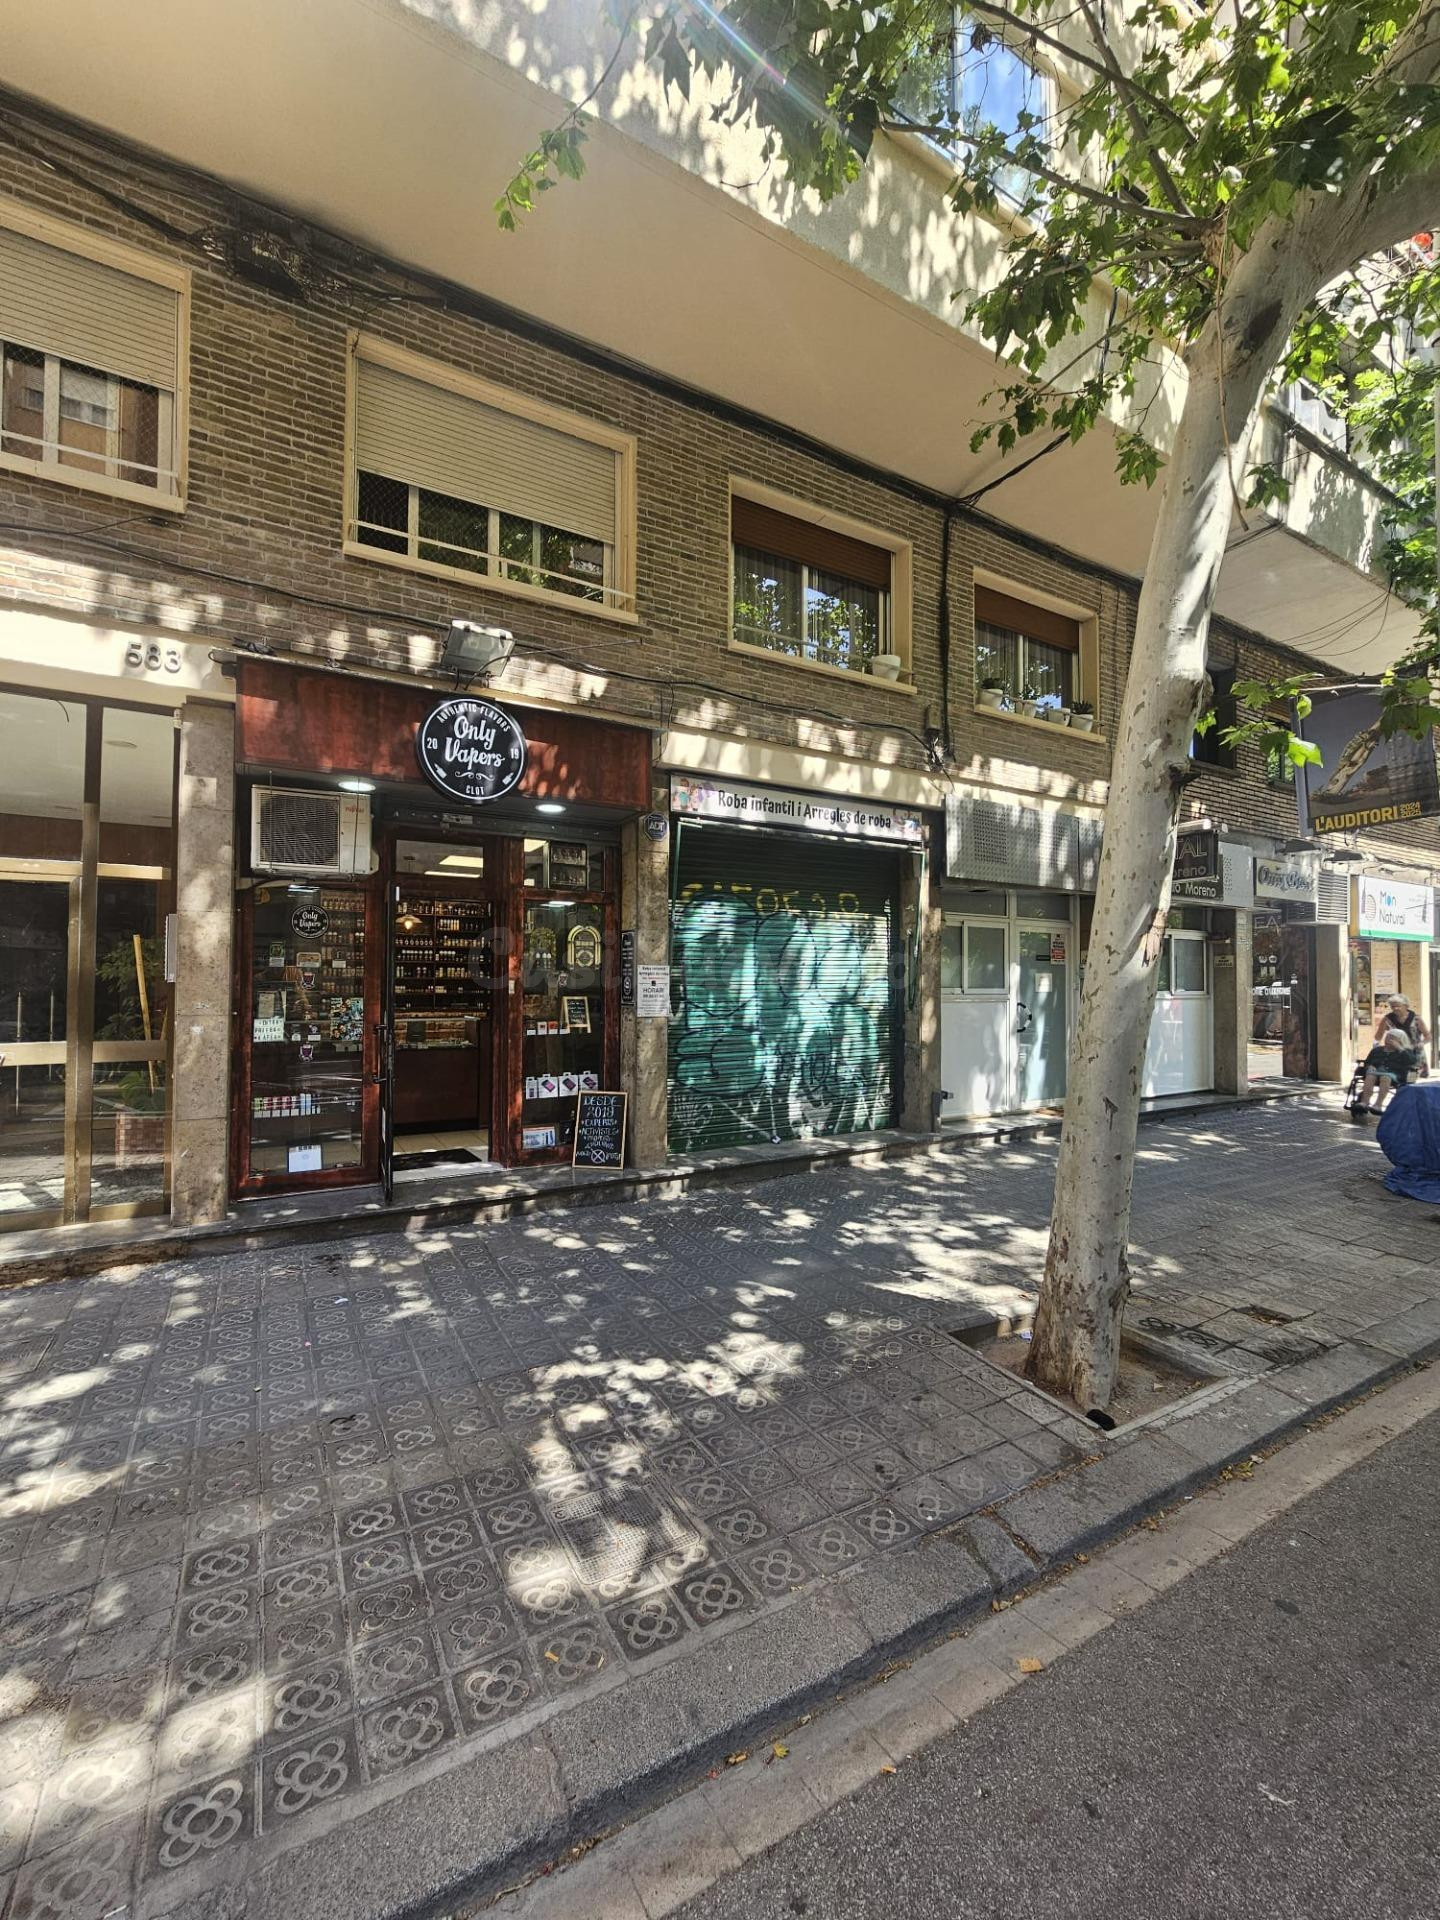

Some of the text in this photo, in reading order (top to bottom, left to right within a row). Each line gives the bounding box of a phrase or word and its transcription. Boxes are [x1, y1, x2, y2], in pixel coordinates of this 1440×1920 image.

[125, 641, 181, 674] 583
[454, 716, 496, 750] Only
[427, 737, 438, 749] 20
[445, 737, 505, 770] Vapers
[510, 748, 520, 759] 19
[465, 785, 485, 795] CLOT
[718, 789, 892, 829] Roba infantil i Arregles de roba
[1314, 805, 1399, 832] L'AUDITORI
[1185, 881, 1217, 898] Moreno
[1379, 890, 1397, 907] Mon
[302, 911, 319, 921] Only
[583, 1096, 618, 1106] DESDE
